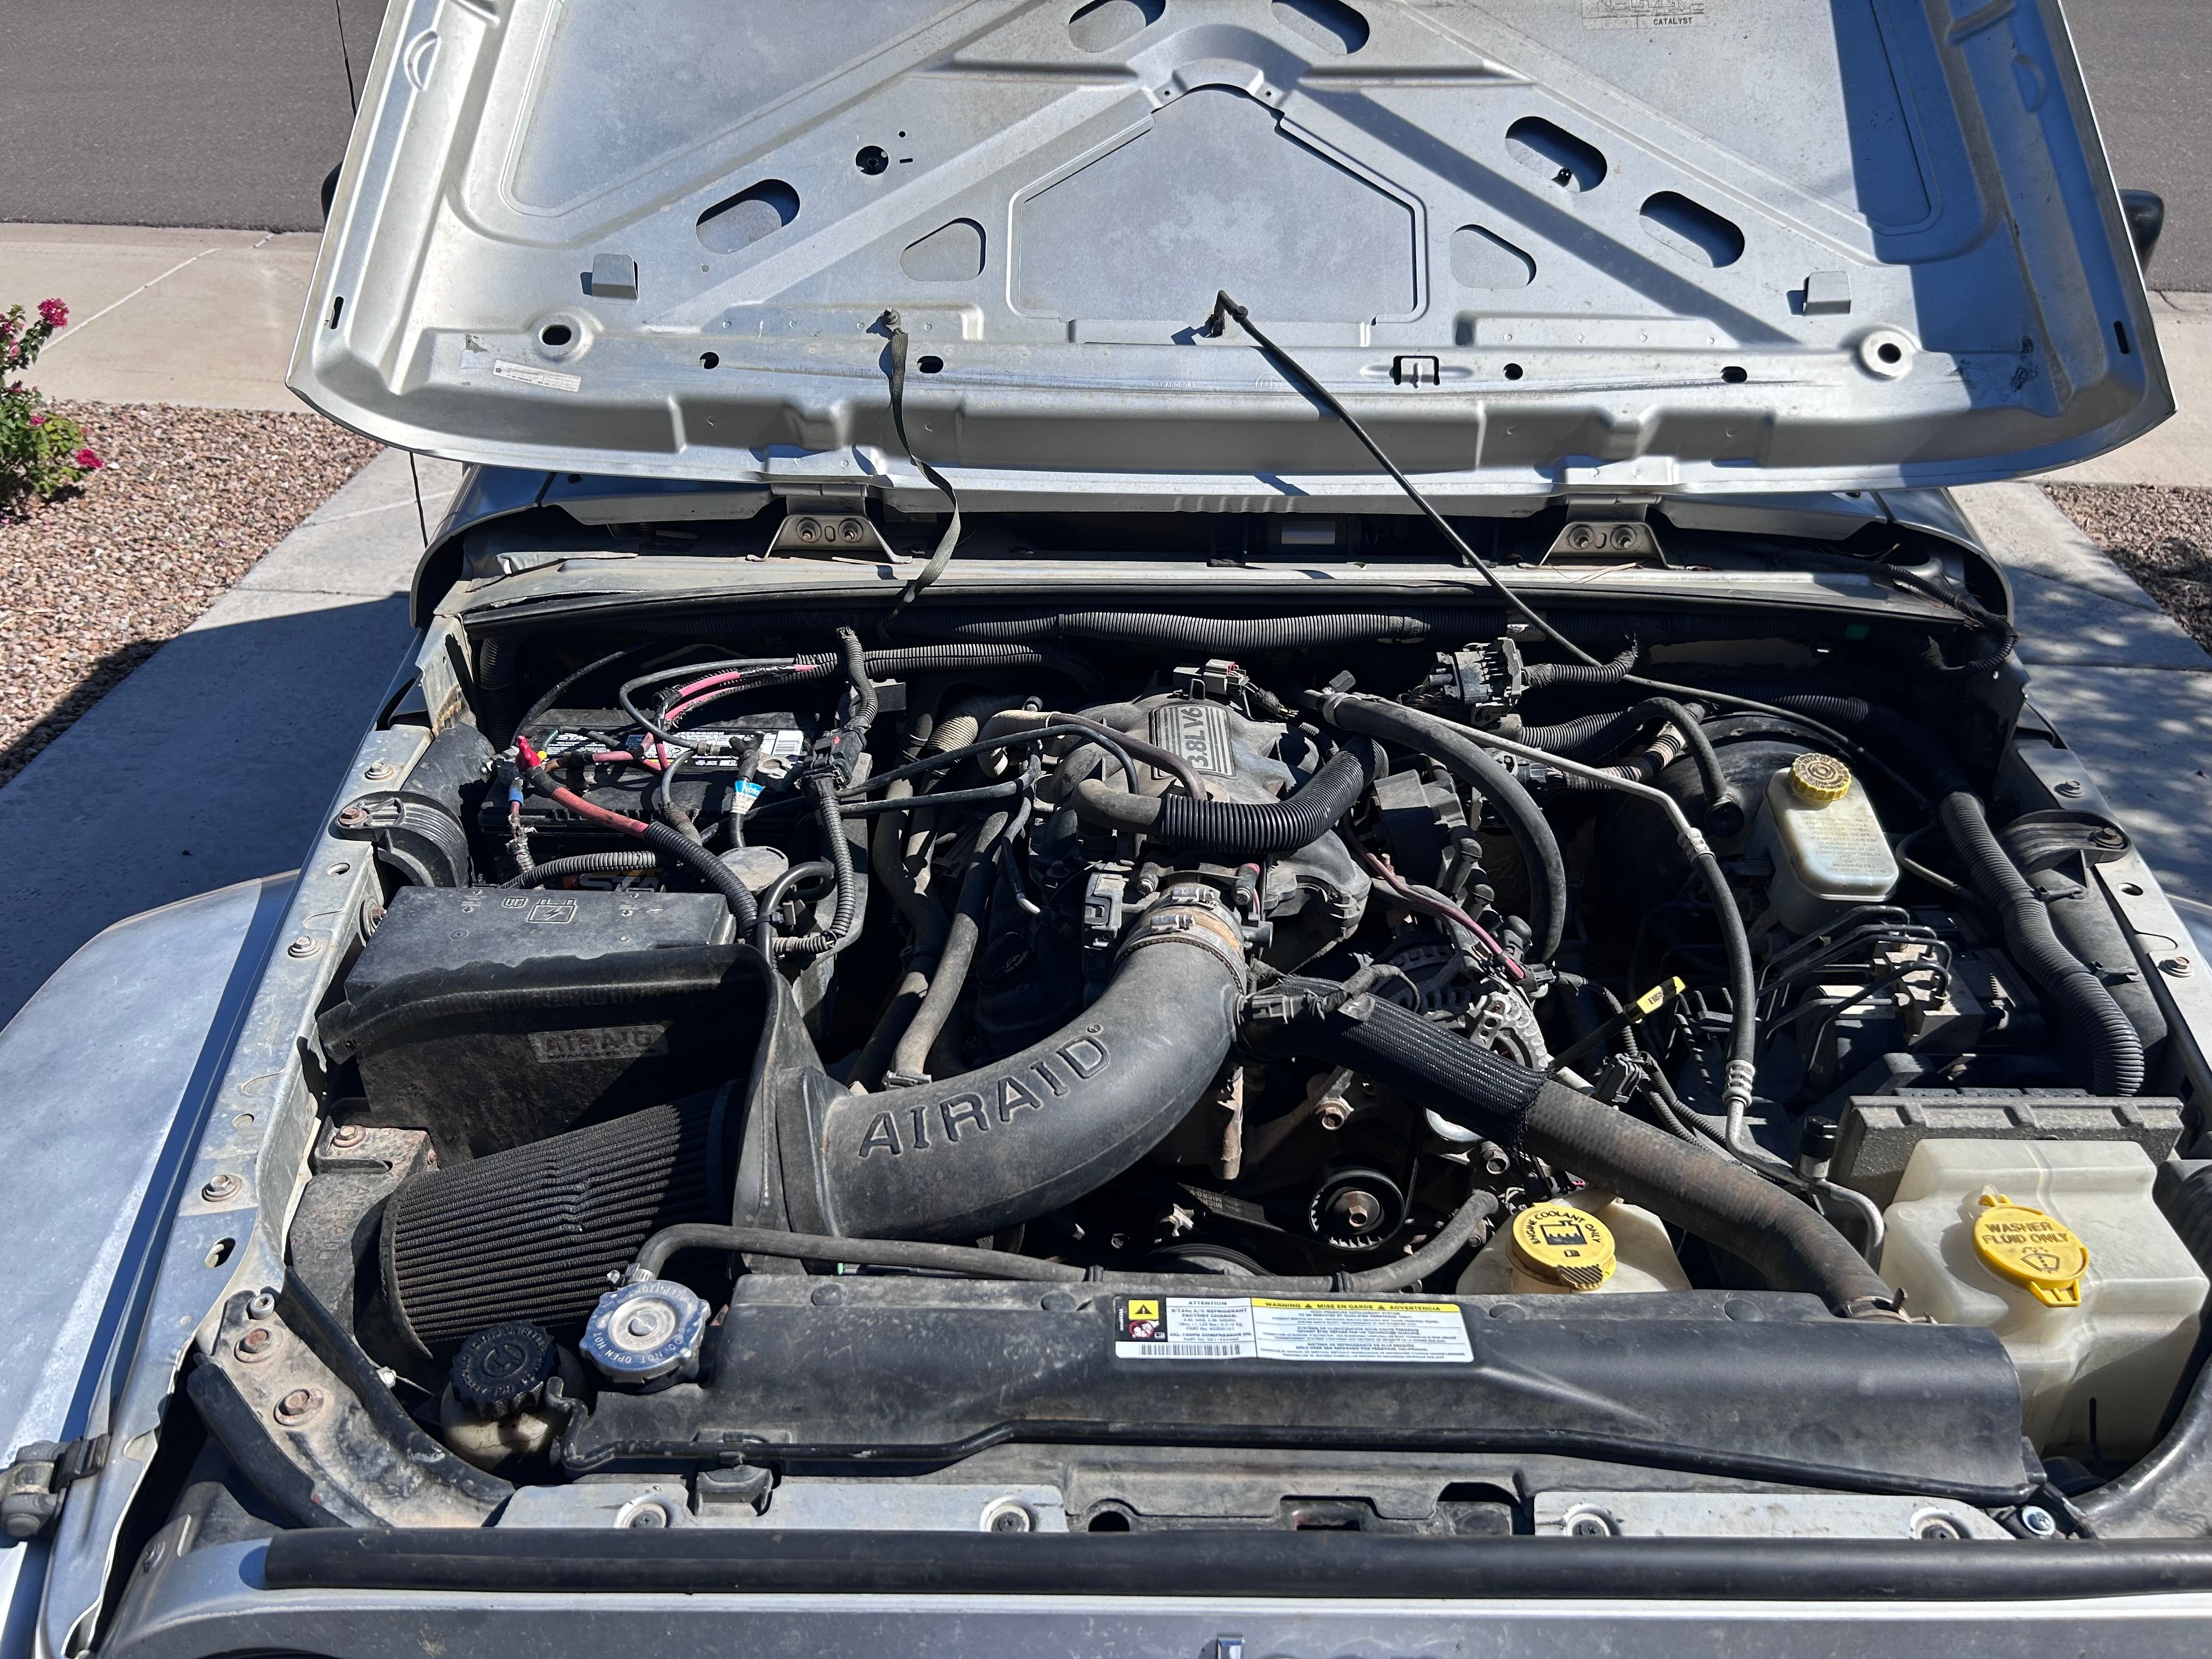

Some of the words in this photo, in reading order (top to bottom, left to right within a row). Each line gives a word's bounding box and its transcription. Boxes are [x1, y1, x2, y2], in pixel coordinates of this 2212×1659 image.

[1653, 17, 1692, 25] CATALYST
[1180, 707, 1204, 729] V6
[546, 1030, 652, 1053] AIRAID
[857, 1032, 1112, 1158] AIRAID
[1526, 1218, 1542, 1245] ENGINE
[1534, 1210, 1585, 1223] COOLANT
[1584, 1223, 1601, 1244] ONLY
[1984, 1221, 2053, 1233] WASHER
[1980, 1233, 2028, 1245] FLUID
[2030, 1232, 2069, 1243] ONLY
[592, 1331, 607, 1350] HOT
[668, 1336, 684, 1351] DO
[605, 1348, 633, 1364] OPEN
[640, 1351, 663, 1364] NOT
